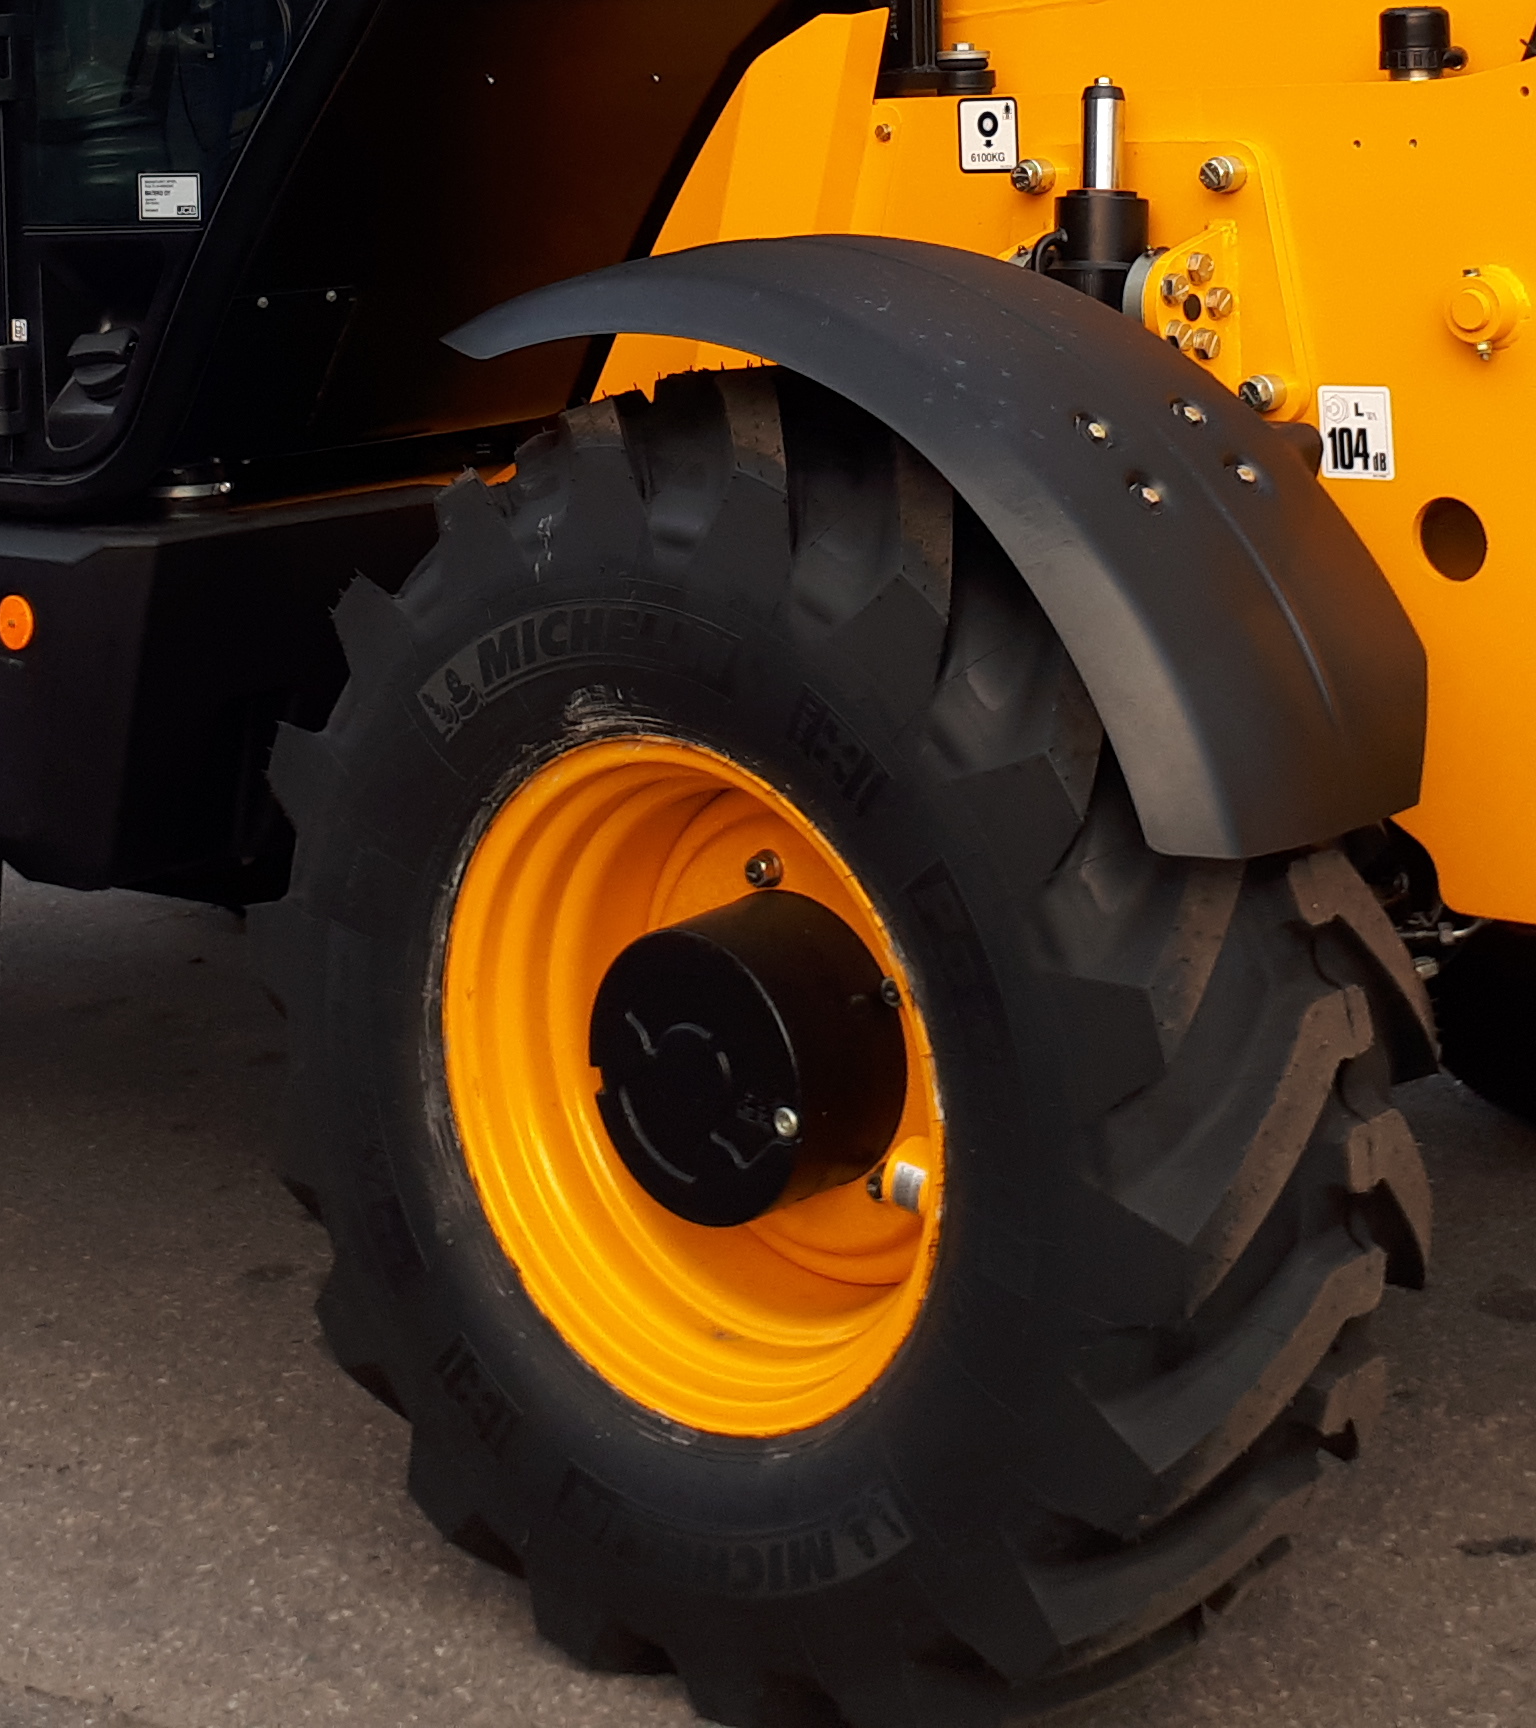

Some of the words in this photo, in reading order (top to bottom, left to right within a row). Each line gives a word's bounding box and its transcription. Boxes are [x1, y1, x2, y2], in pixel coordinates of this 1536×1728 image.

[970, 152, 1006, 163] 6100KG
[1327, 427, 1370, 470] 104
[1373, 452, 1387, 471] dB
